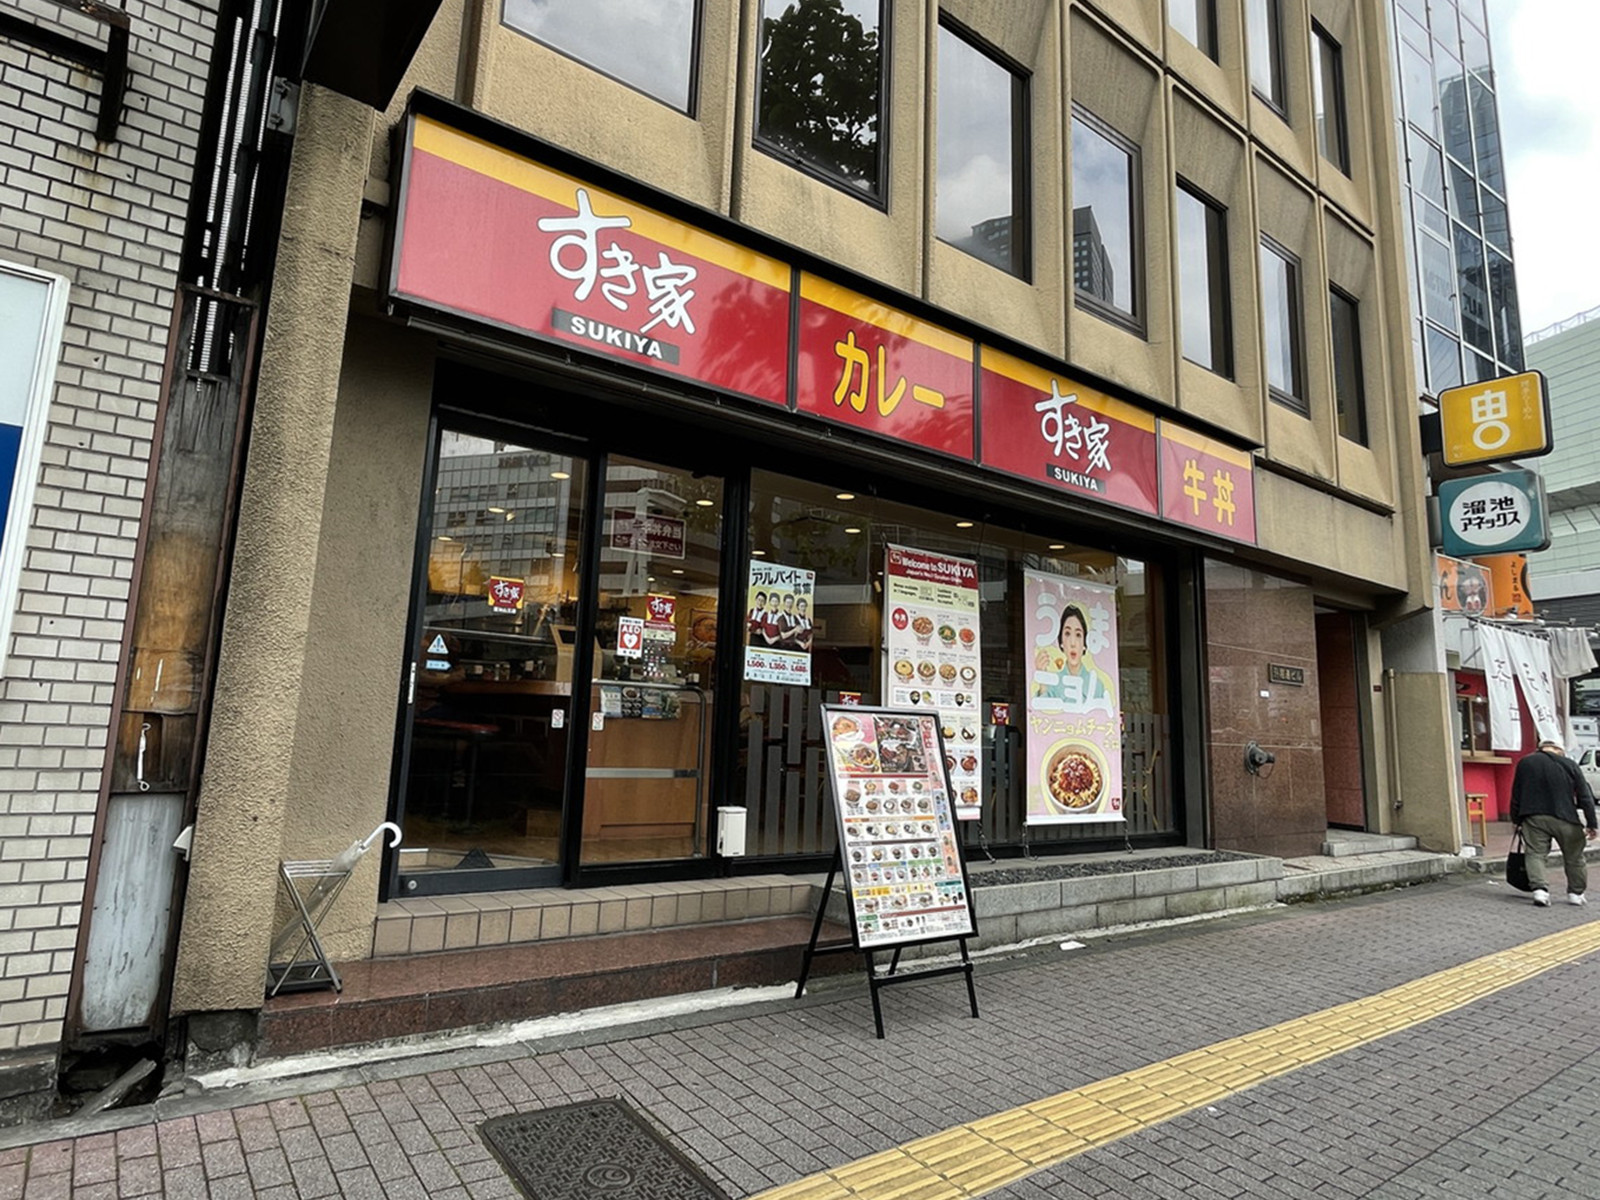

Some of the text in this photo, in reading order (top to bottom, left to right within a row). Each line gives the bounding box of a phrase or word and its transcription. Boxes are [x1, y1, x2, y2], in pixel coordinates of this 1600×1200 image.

[537, 188, 698, 335] すき家
[570, 315, 664, 360] SUKIYA
[833, 330, 946, 418] カレー
[1034, 379, 1111, 475] すき家
[1053, 466, 1100, 492] SUKIYA
[1183, 458, 1236, 526] 牛丼
[1462, 496, 1515, 516] 溜池
[1459, 511, 1521, 532] アネックス
[752, 570, 801, 586] アルバイト
[902, 557, 930, 571] Welcome
[937, 562, 975, 579] SUKIYA
[621, 625, 642, 634] AED
[1030, 716, 1117, 737] ヤンニョムチーズ
